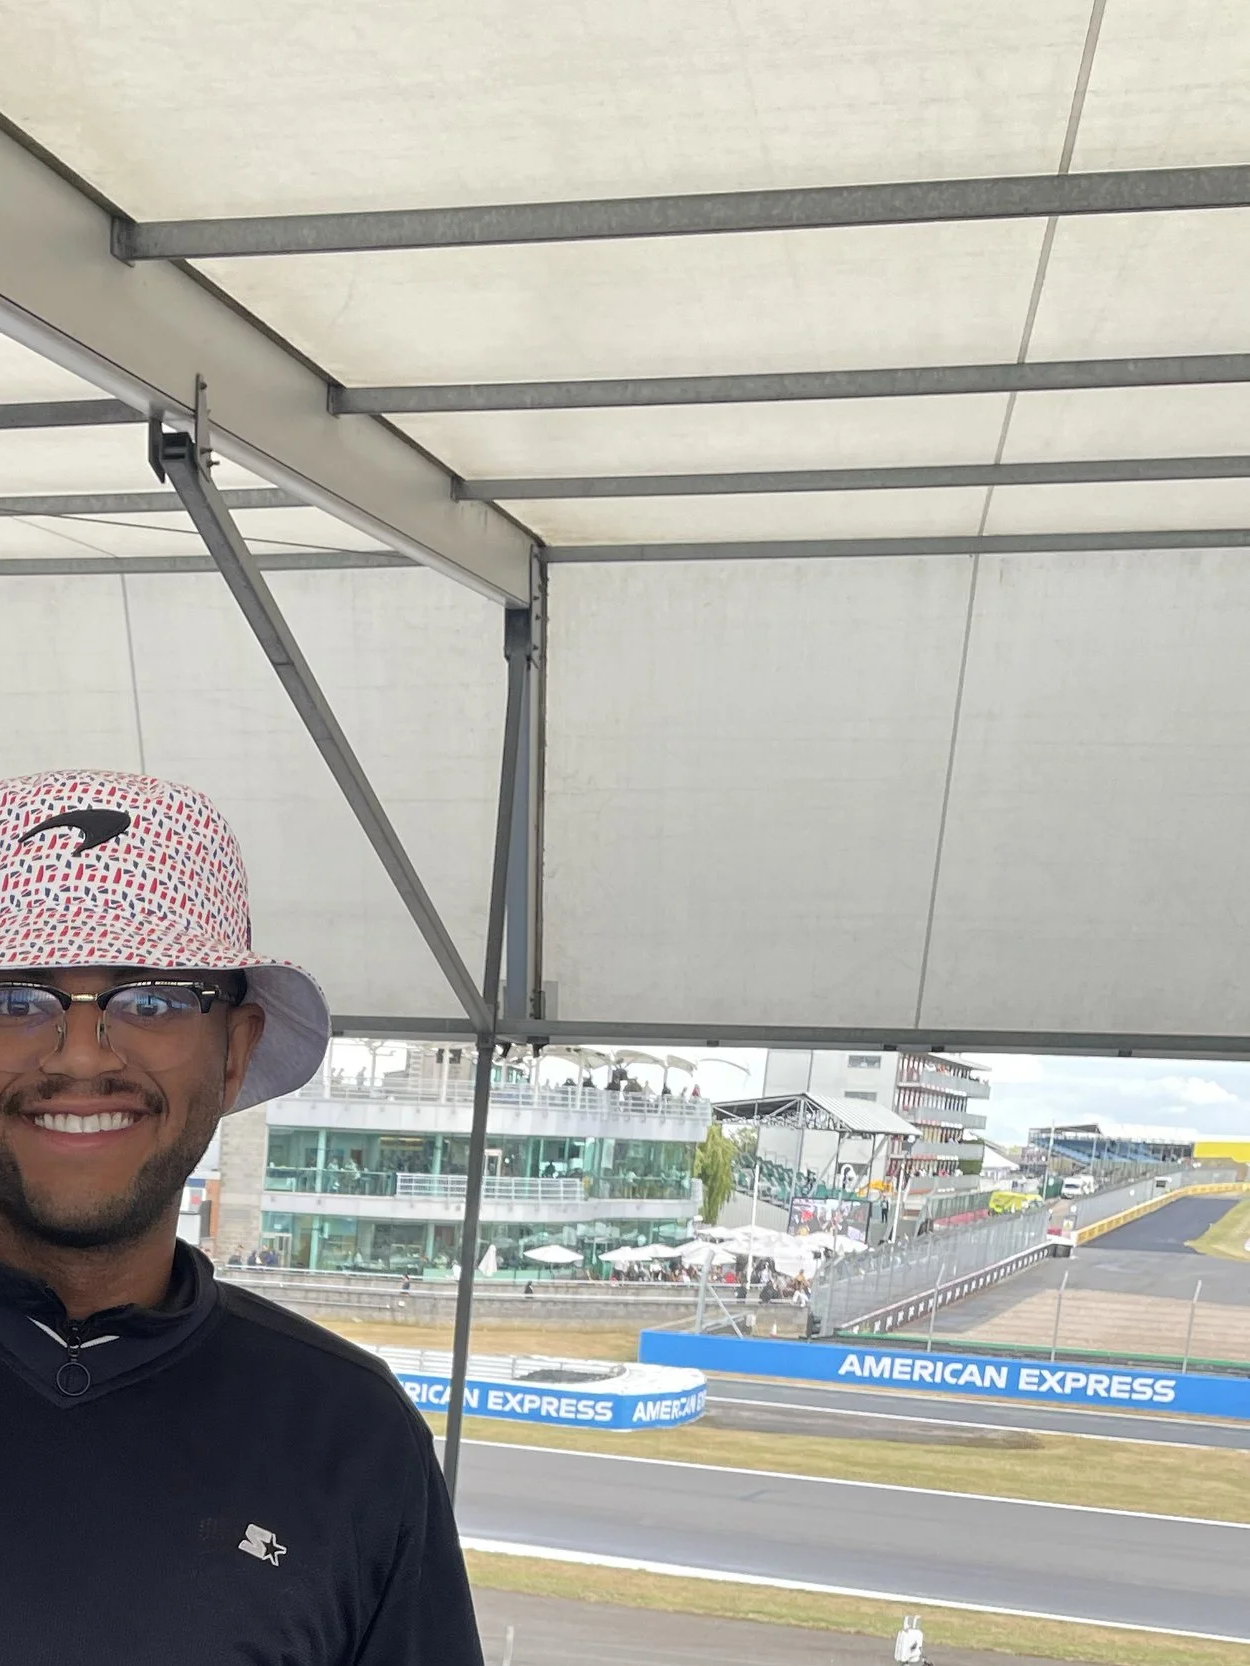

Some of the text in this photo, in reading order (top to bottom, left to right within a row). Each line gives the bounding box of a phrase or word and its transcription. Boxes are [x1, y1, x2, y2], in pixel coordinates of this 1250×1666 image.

[838, 1353, 1177, 1403] AMERICAN EXPRESS
[487, 1390, 613, 1422] EXPRESS
